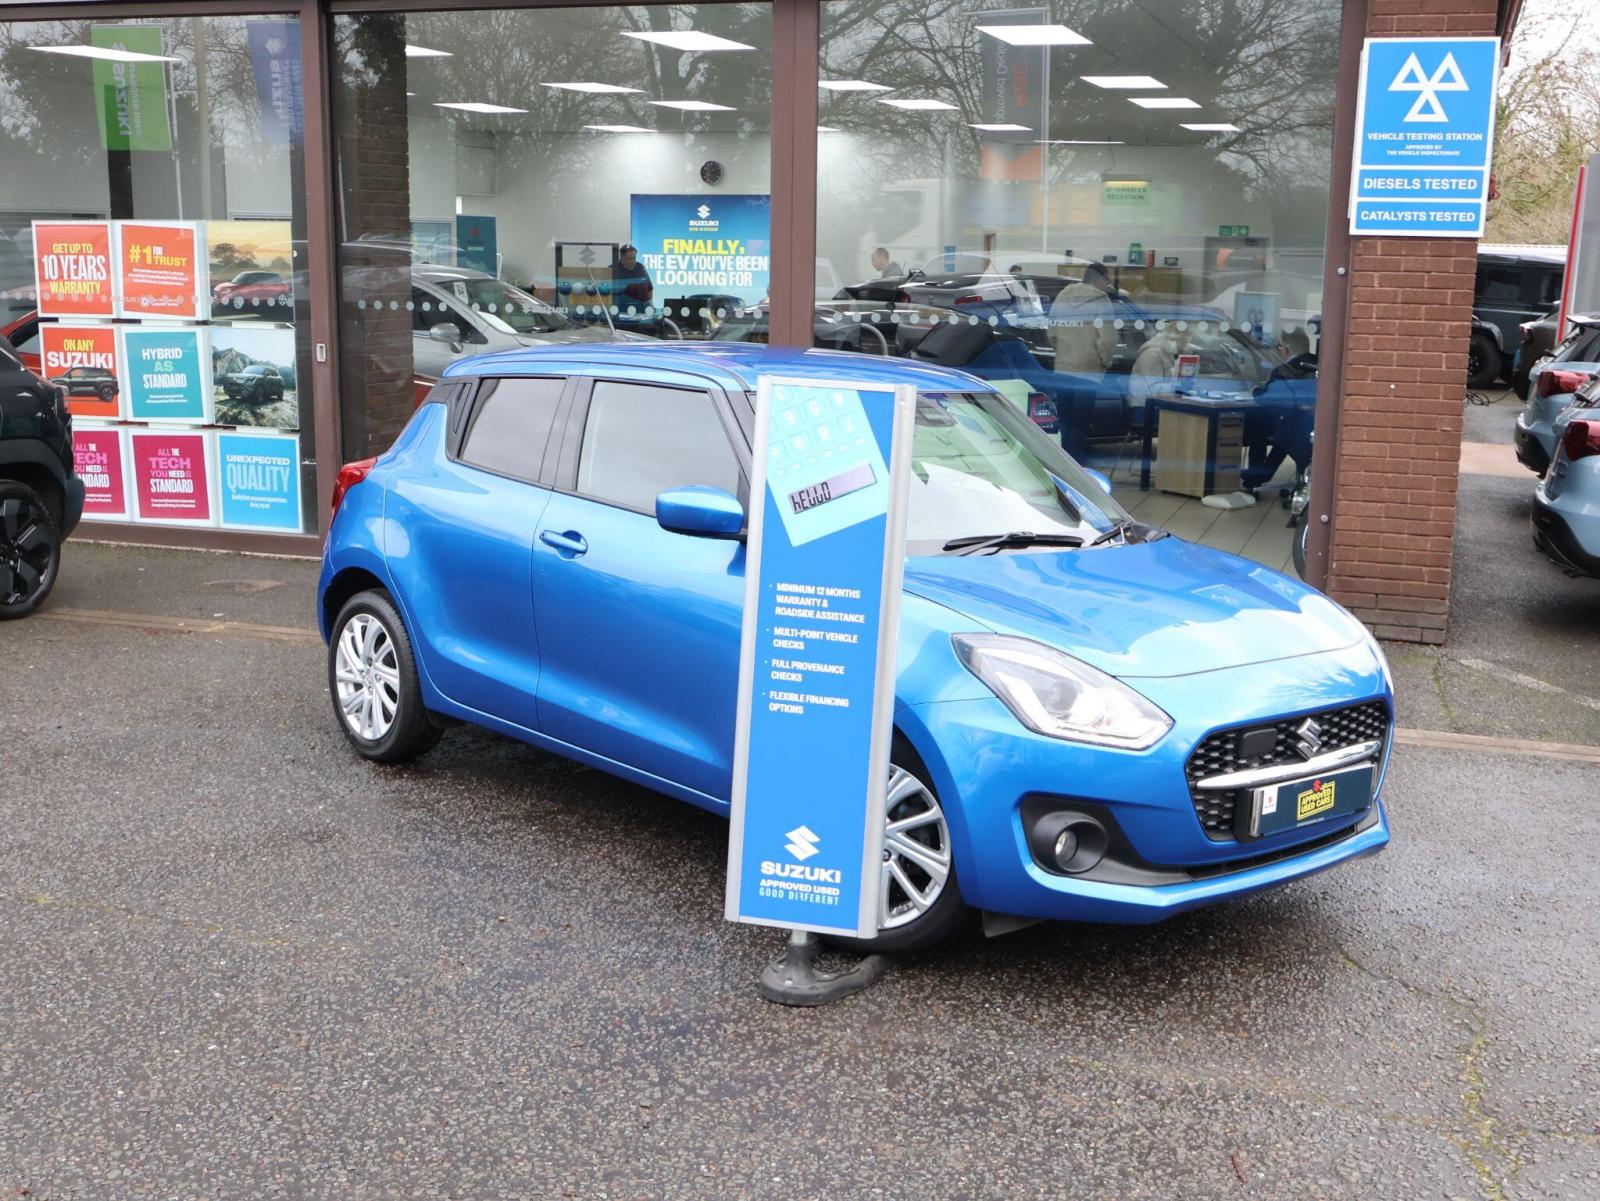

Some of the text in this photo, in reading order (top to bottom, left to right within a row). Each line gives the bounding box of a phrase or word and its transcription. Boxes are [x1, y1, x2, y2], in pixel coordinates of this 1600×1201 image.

[1367, 133, 1483, 141] VEHICLE TESTING STATION
[1363, 178, 1478, 191] DIESELS TESTED
[1360, 210, 1476, 222] CATALYSTS TESTED
[52, 243, 93, 254] GET UP TO
[663, 239, 745, 255] FINALLY,
[128, 244, 152, 265] #1
[152, 256, 187, 267] TRUST
[42, 254, 107, 281] 10 YEARS
[642, 254, 769, 271] THE EV YOU'VE BEEN
[656, 270, 753, 287] LOOKING FOR
[50, 281, 101, 295] WARRANTY
[64, 339, 95, 352] ON ANY
[46, 351, 113, 369] SUZUKI
[142, 348, 183, 360] HYBRID
[154, 360, 173, 372] AS
[143, 373, 187, 389] STANDARD
[76, 443, 88, 452] ALL
[158, 448, 171, 456] ALL
[74, 452, 108, 465] ECH
[148, 457, 191, 470] TECH
[226, 454, 290, 466] UNEXPECTED
[74, 464, 85, 473] OU
[85, 464, 102, 473] NEED
[150, 470, 168, 478] YOU
[168, 470, 186, 478] NEED
[226, 463, 290, 494] QUALITY
[150, 478, 194, 494] STANDARD
[776, 582, 861, 599] MINIMUM 12 MONTHS
[776, 594, 829, 608] WARRANTY &
[775, 606, 866, 624] ROADSIDE ASSISTANCE
[774, 626, 858, 644] MULTI-POINT VEHICLE
[773, 639, 805, 650] CHECKS
[772, 658, 846, 675] FULL PROVENANCE
[770, 671, 802, 682] CHECKS
[769, 690, 850, 708] FLEXIBLE FINANCING
[768, 703, 804, 715] OPTIONS
[760, 860, 842, 884] SUZUKI
[760, 878, 840, 896] APPROVED USED
[759, 887, 839, 906] GOOD DIFFERENT
